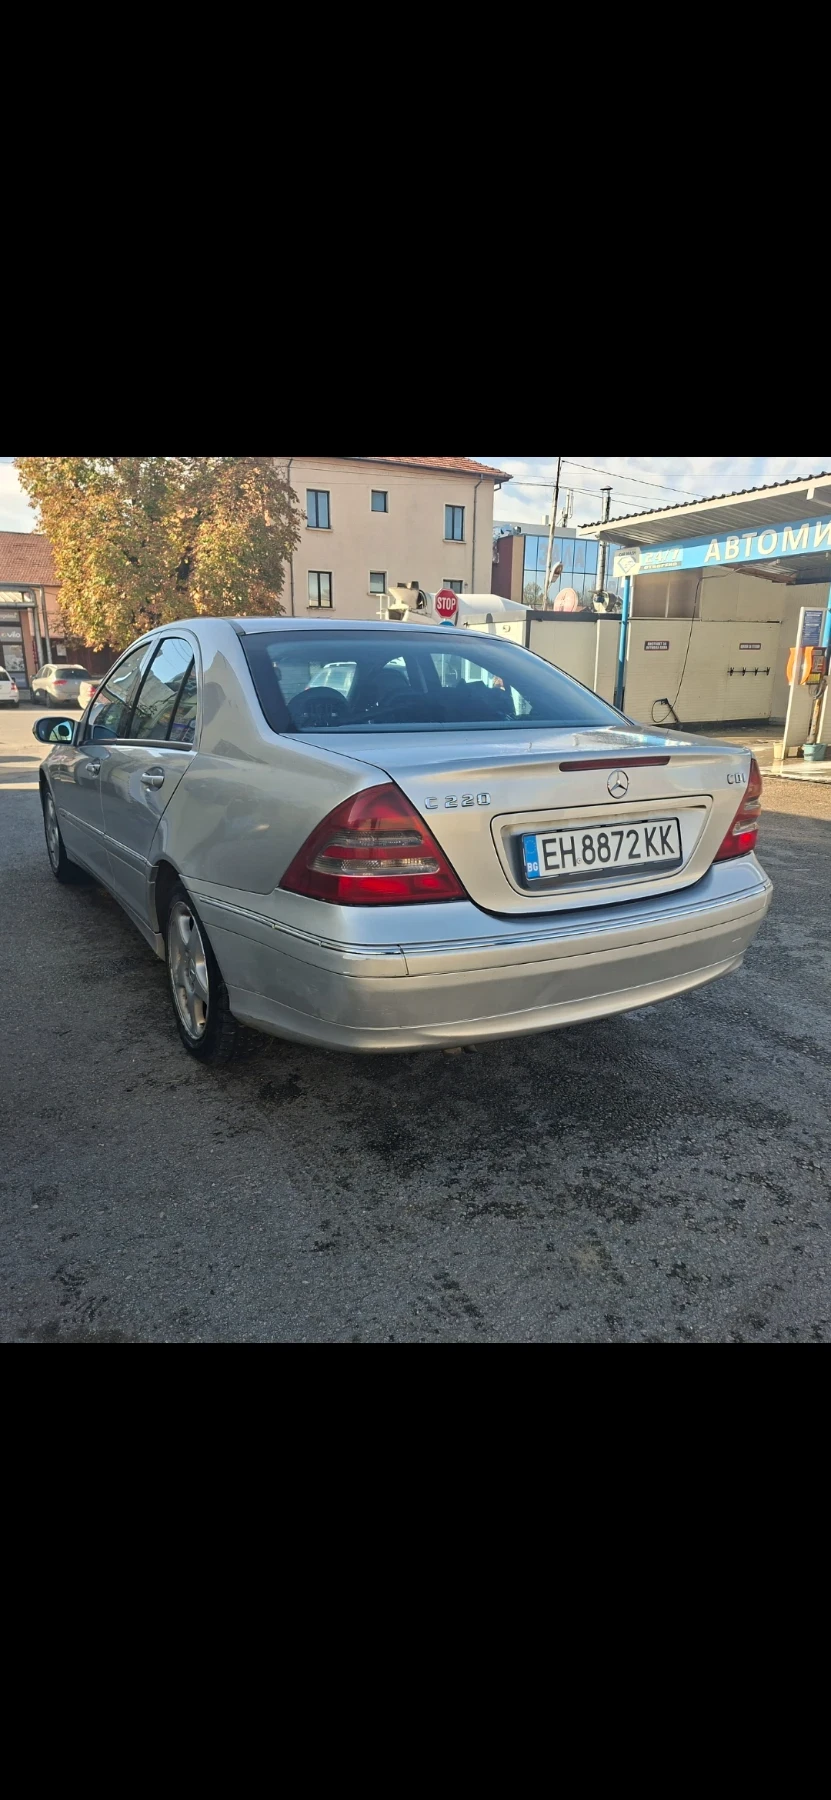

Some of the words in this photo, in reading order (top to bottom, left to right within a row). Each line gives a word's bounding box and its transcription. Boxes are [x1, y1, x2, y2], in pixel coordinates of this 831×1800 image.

[704, 520, 831, 562] АВТОМИ
[645, 548, 680, 564] 24/7
[437, 596, 456, 610] STOP
[726, 771, 747, 785] CDI
[424, 796, 439, 810] C
[444, 792, 491, 809] 220
[526, 861, 539, 873] BG
